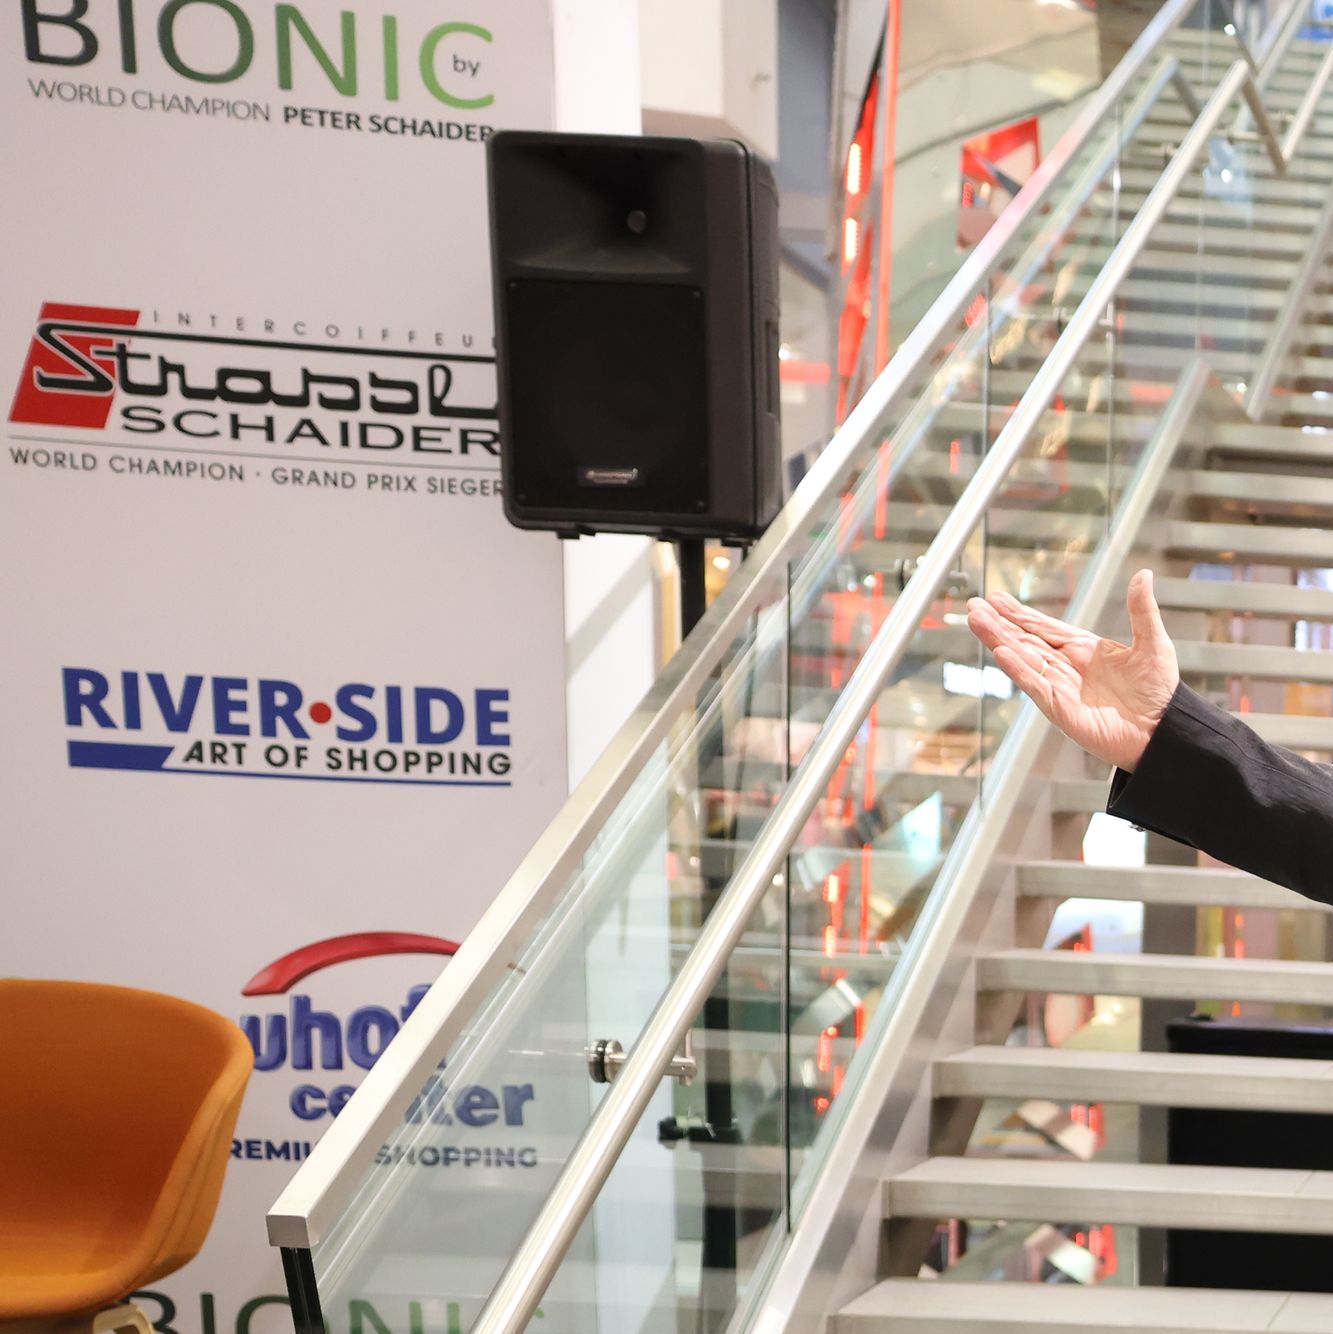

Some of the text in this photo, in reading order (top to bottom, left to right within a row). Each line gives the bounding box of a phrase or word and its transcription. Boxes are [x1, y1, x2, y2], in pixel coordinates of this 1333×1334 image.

[21, 0, 494, 109] BIONIC
[453, 54, 480, 77] by
[27, 77, 494, 143] WORLD CHAMPION PETER SCHAIDER
[153, 310, 497, 349] INTERCOIFFEU
[121, 405, 502, 456] SCHAIDER
[9, 447, 97, 471] WORLD
[109, 455, 244, 481] CHAMPION
[272, 467, 356, 489] GRAND
[367, 474, 417, 492] PRIX
[182, 740, 512, 776] ART OF SHOPPING
